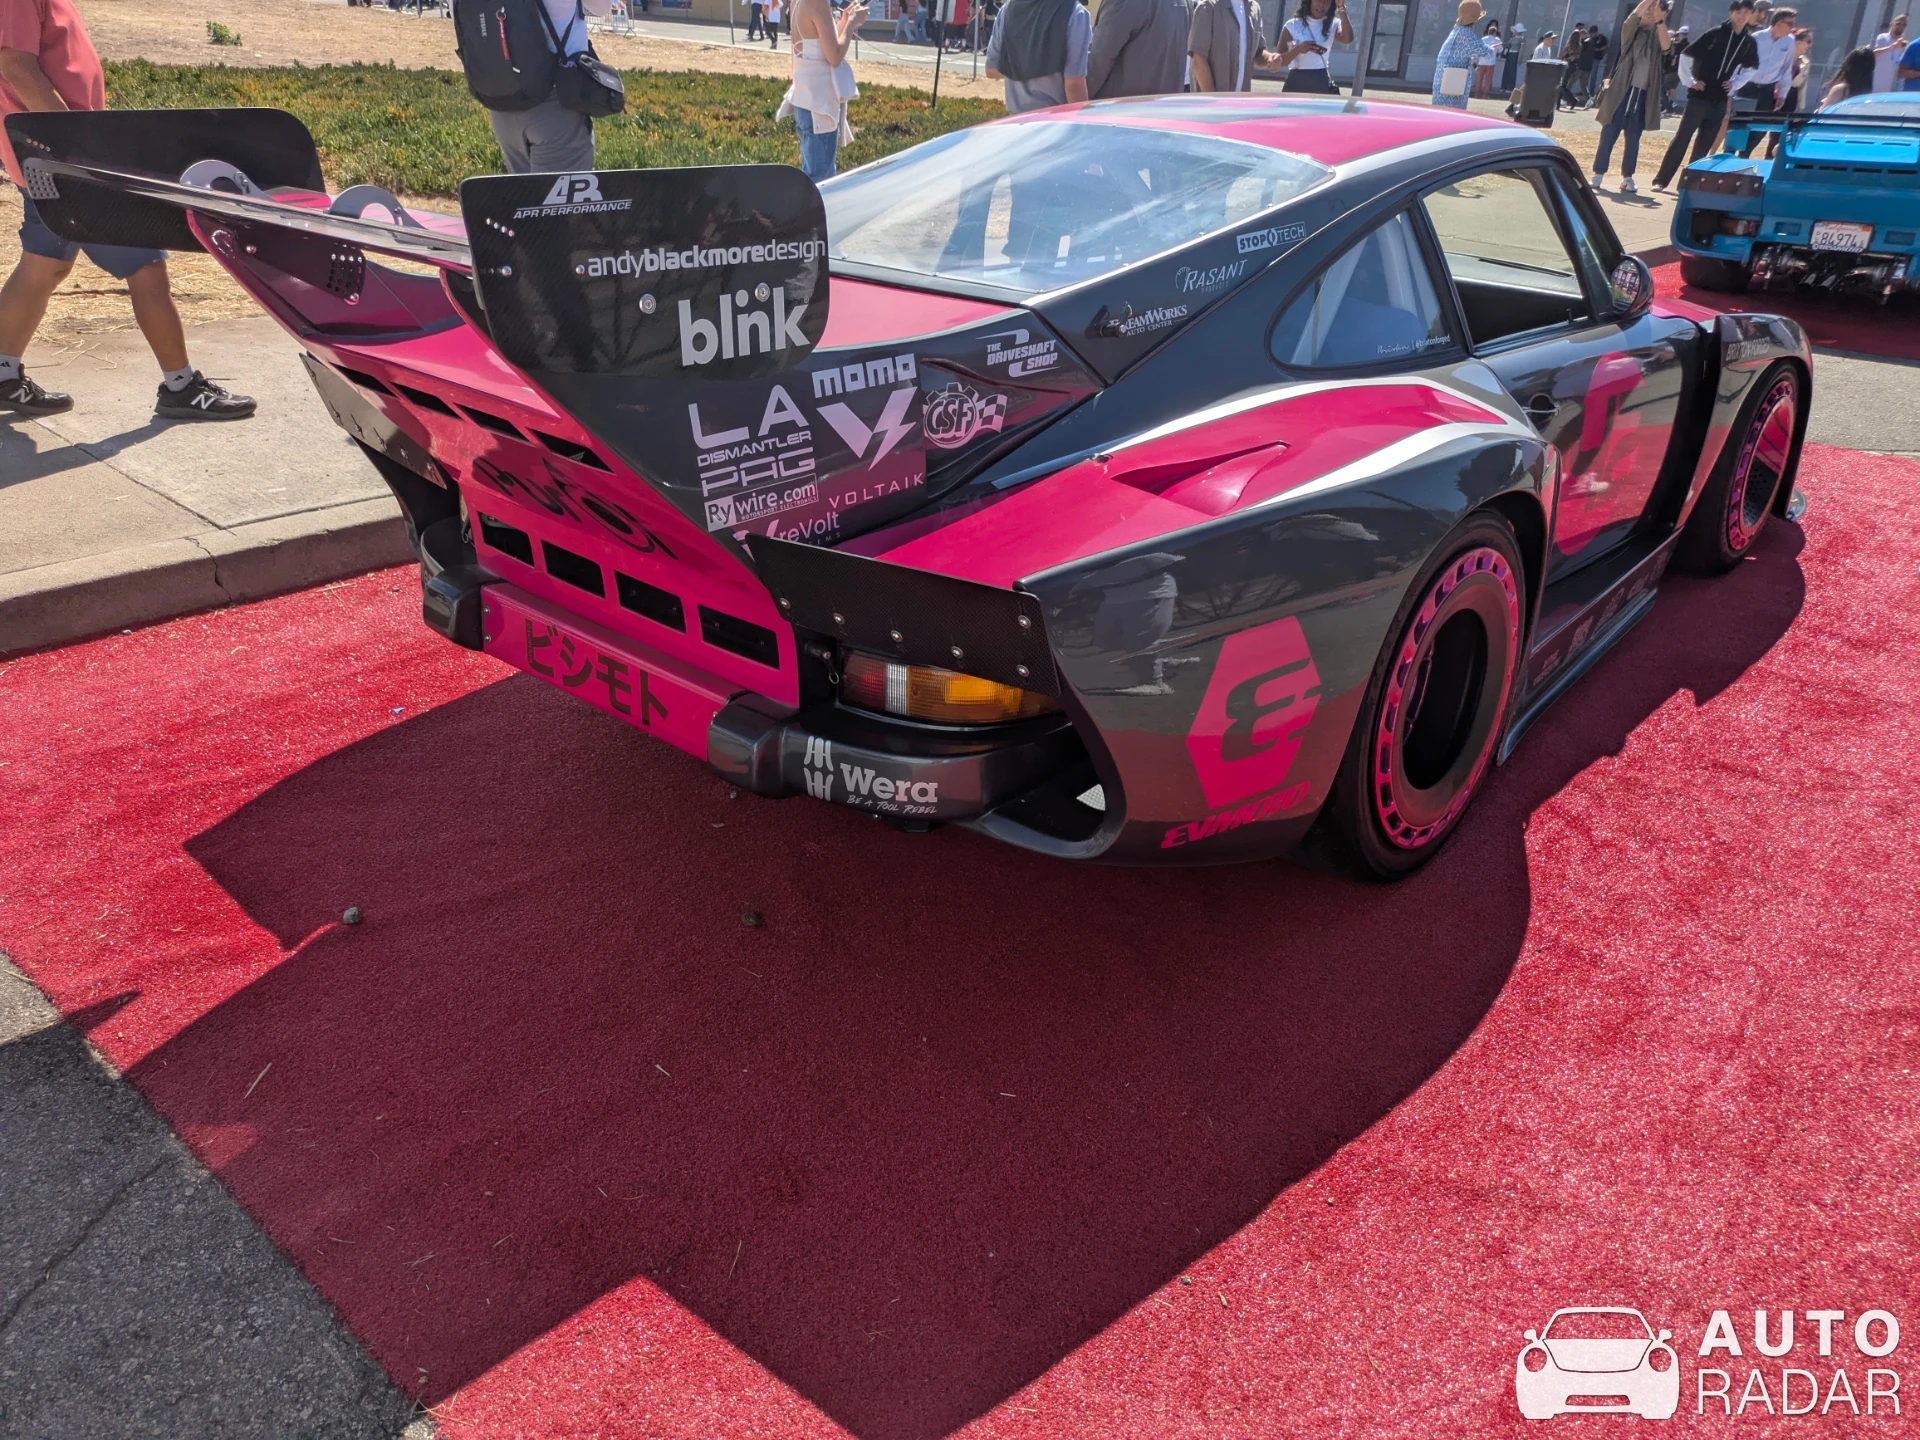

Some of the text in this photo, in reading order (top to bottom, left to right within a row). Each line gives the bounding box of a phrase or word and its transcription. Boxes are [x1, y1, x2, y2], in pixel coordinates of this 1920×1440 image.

[513, 201, 632, 219] APR PERFORMANCE
[587, 238, 826, 278] andyblackmoredesign
[1820, 232, 1857, 247] 84974
[1183, 260, 1248, 293] RASANT
[677, 286, 811, 367] blink
[1126, 320, 1173, 337] AUTO CENTER
[987, 342, 1002, 353] THE
[987, 340, 1057, 366] DRIVESHAFT
[1026, 352, 1058, 370] SHOP
[688, 384, 810, 450] LA
[926, 397, 973, 439] CSF
[697, 430, 812, 467] DISMANTLER
[700, 446, 816, 498] PAG
[829, 472, 924, 509] VOLTAIK
[741, 496, 817, 521] MOTORSPORT ELECTRONICS
[525, 618, 669, 727] ビシモト
[840, 762, 938, 803] Wera
[847, 795, 863, 805] BE
[877, 801, 899, 812] TOOL
[903, 804, 937, 815] REBEL
[1160, 781, 1311, 849] EVMOTO
